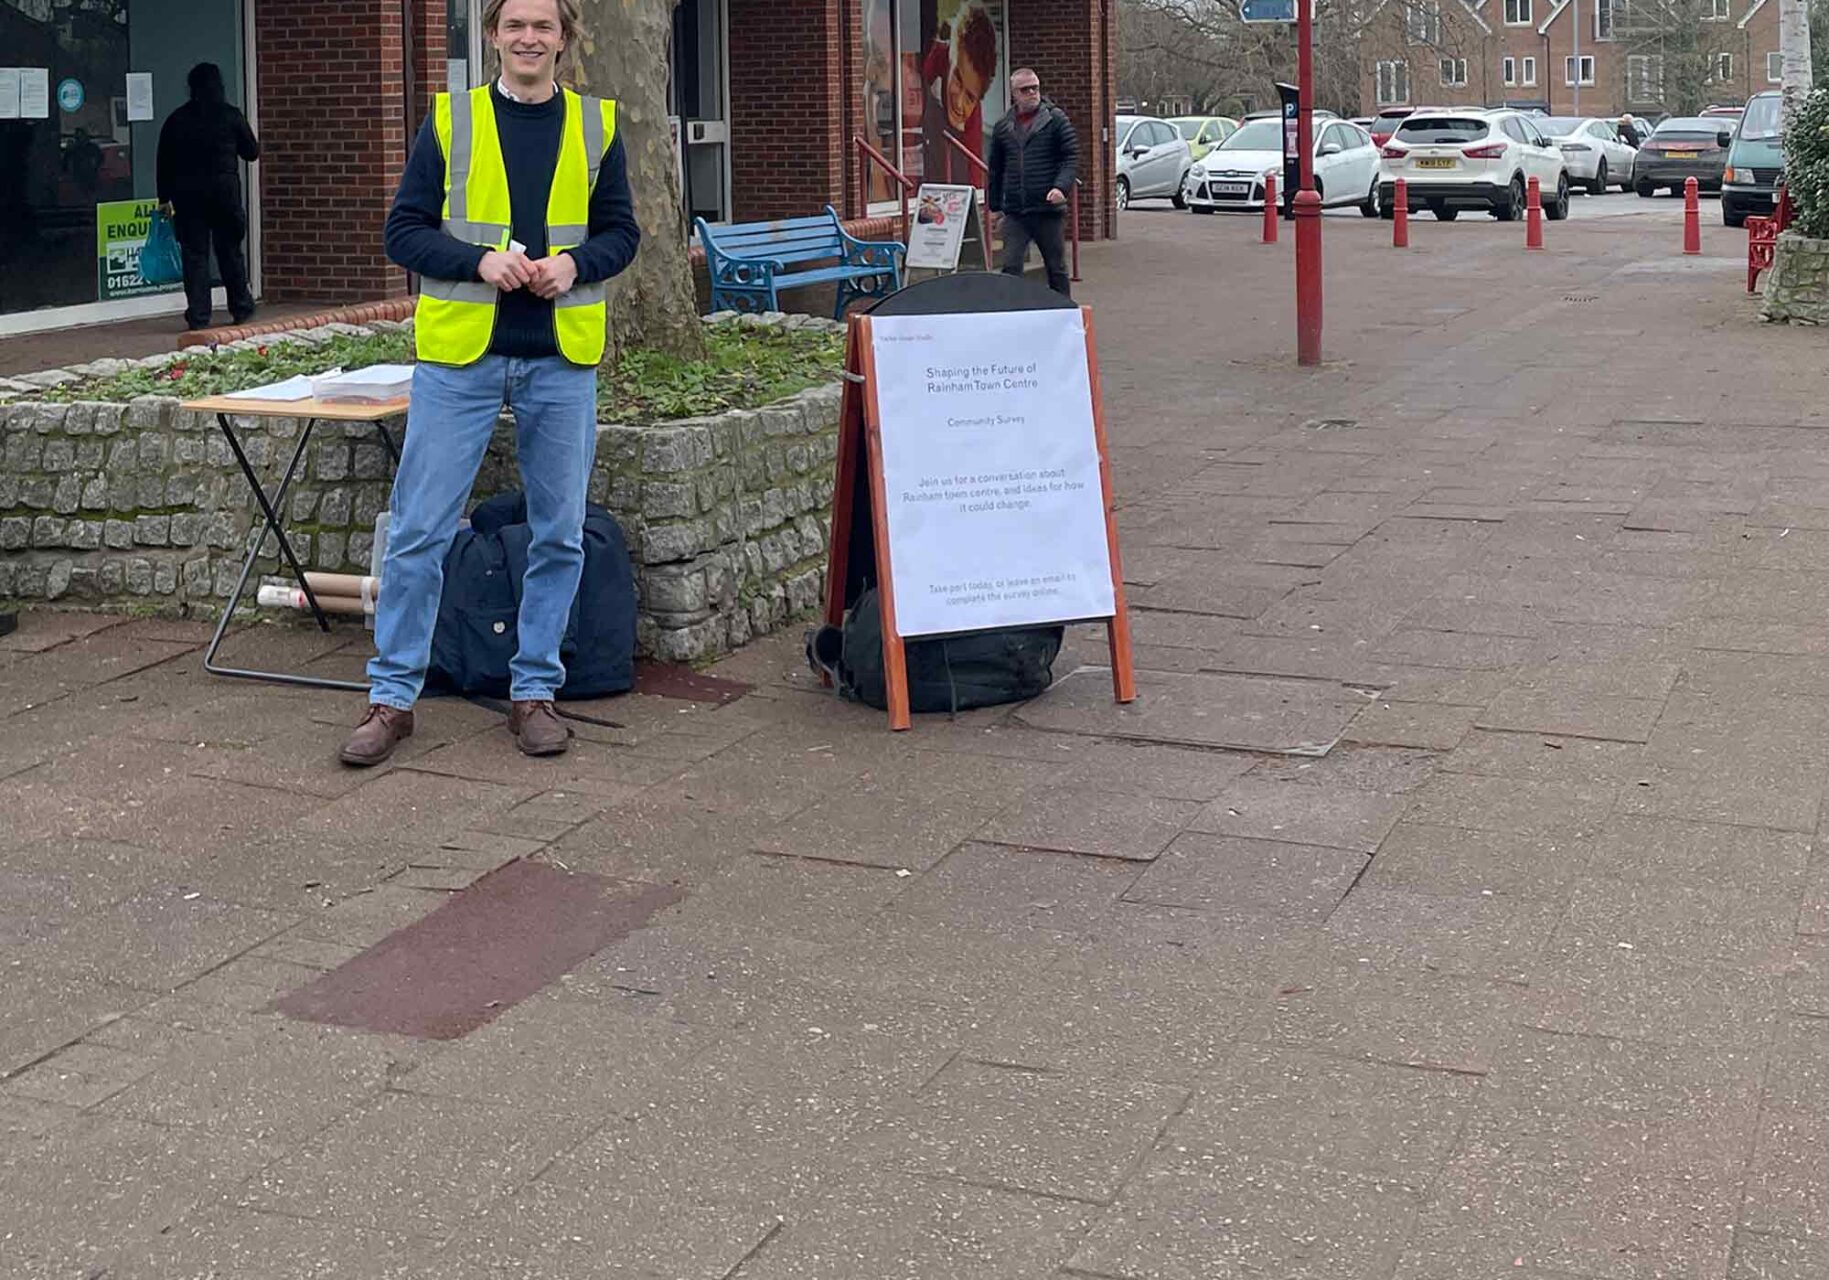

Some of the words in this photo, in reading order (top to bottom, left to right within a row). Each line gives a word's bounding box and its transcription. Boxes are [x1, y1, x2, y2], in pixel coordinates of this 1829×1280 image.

[926, 367, 970, 379] Shaping
[972, 365, 989, 376] the
[991, 363, 1024, 375] Future
[1026, 362, 1037, 373] of
[927, 381, 973, 393] Rainham
[974, 380, 1001, 390] Town
[1003, 378, 1038, 389] Centre
[947, 416, 995, 428] Community
[997, 415, 1025, 426] Survey
[918, 476, 939, 488] Join
[941, 477, 953, 486] us
[955, 475, 968, 485] for
[970, 476, 977, 484] a
[977, 471, 1037, 483] conversation
[1038, 469, 1066, 479] about
[902, 491, 943, 503] Rainham
[1004, 484, 1021, 495] and
[1023, 483, 1048, 493] ideas
[1049, 481, 1062, 491] for
[1064, 480, 1085, 490] how
[959, 502, 967, 513] it
[968, 500, 995, 512] could
